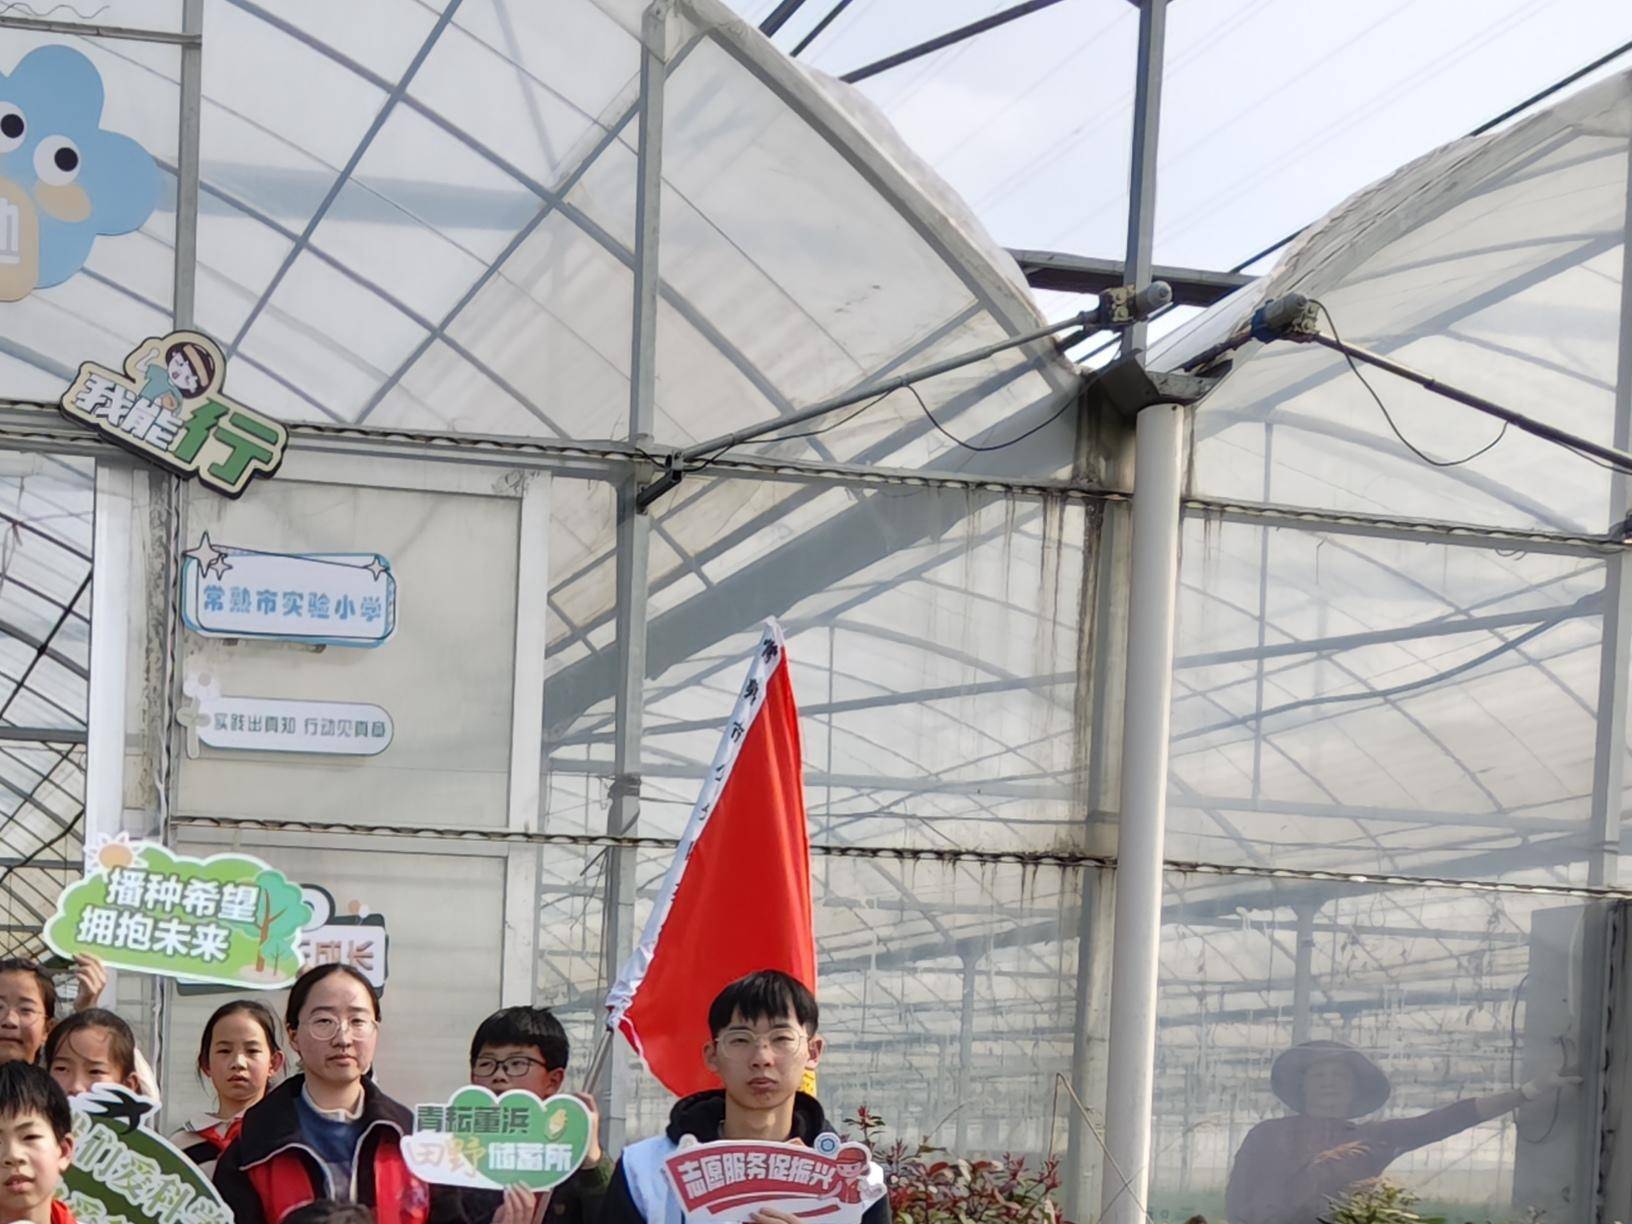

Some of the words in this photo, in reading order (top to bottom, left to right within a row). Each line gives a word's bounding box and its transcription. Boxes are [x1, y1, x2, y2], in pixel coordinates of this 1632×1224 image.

[74, 371, 279, 487] 我能行
[202, 584, 383, 623] 常熟市实验小学
[212, 711, 297, 735] 实践出真知
[104, 868, 262, 924] 播种希望
[74, 905, 233, 963] 拥抱未来
[416, 1105, 530, 1134] 青耘董浜
